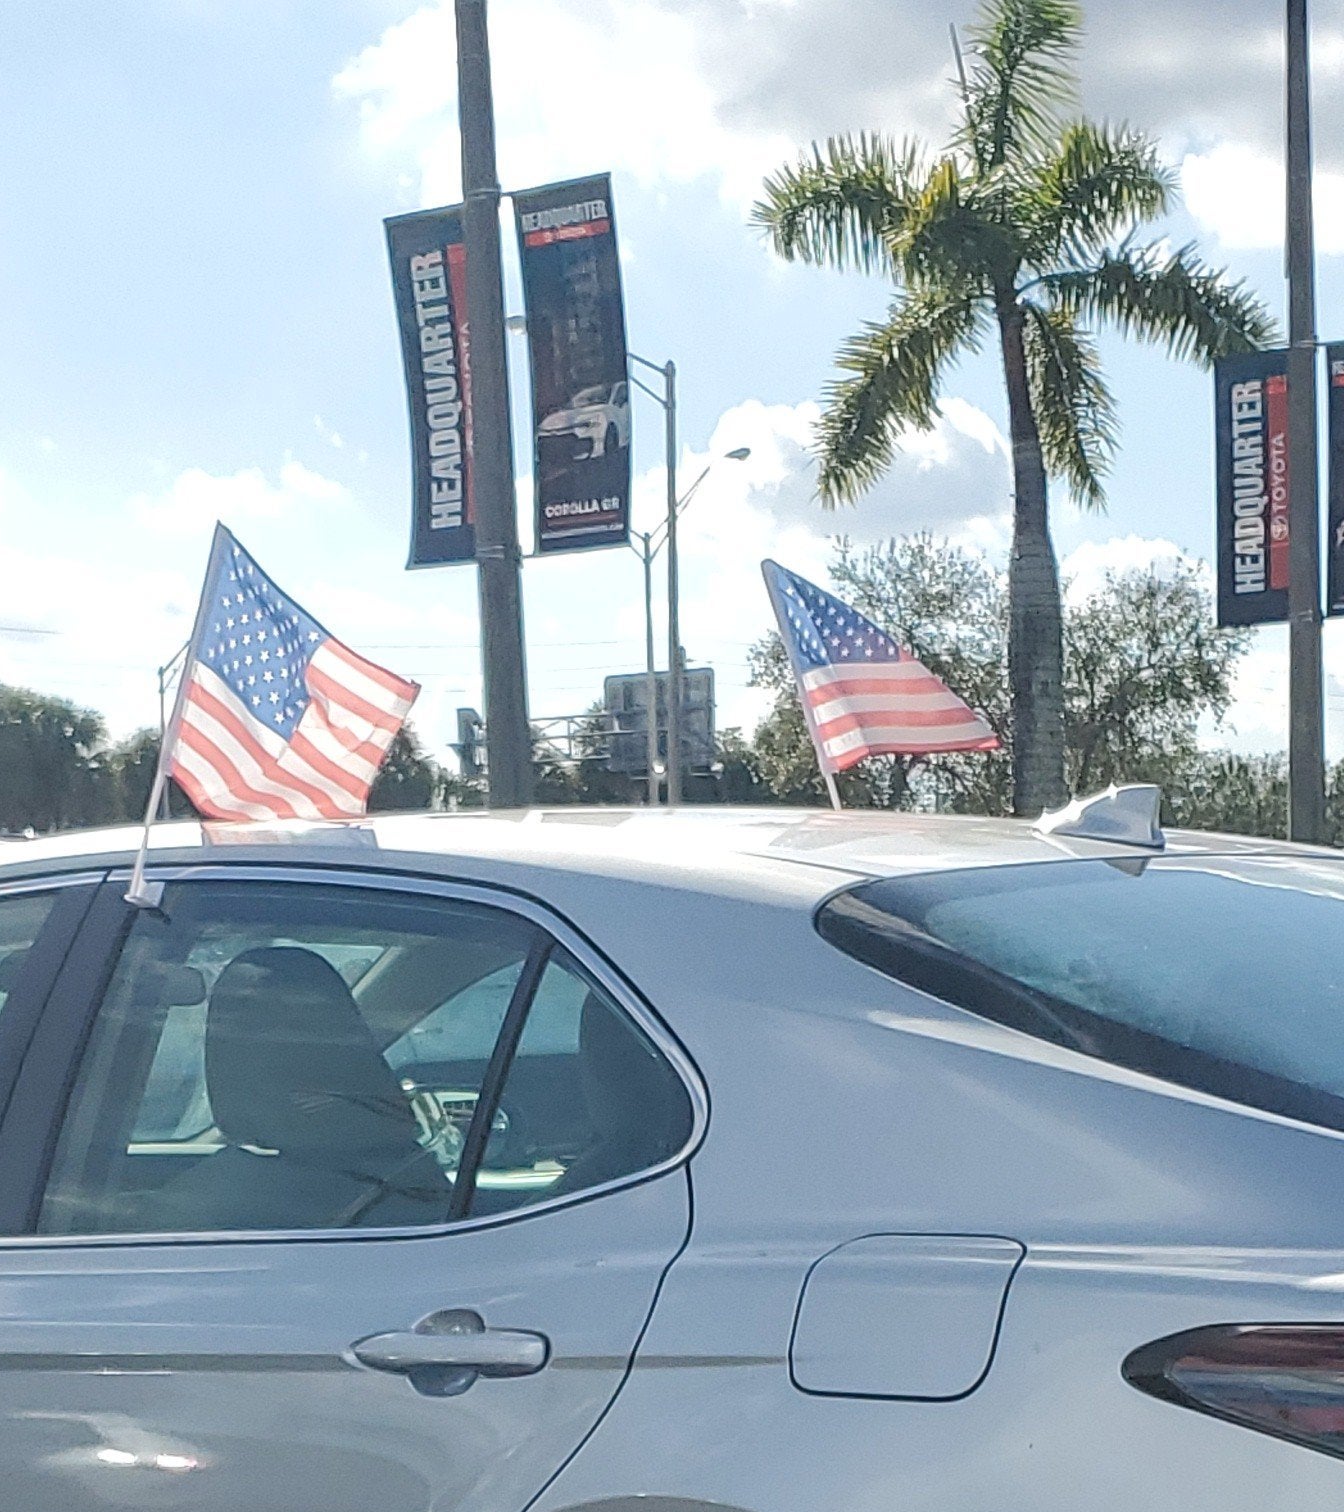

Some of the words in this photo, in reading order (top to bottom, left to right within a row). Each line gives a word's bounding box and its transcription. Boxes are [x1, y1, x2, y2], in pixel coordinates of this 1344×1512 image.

[410, 249, 462, 530] HEADQUARTER
[545, 499, 600, 518] COROLLA
[1231, 379, 1268, 594] HEADQUARTER
[1269, 432, 1287, 520] TOYOTA
